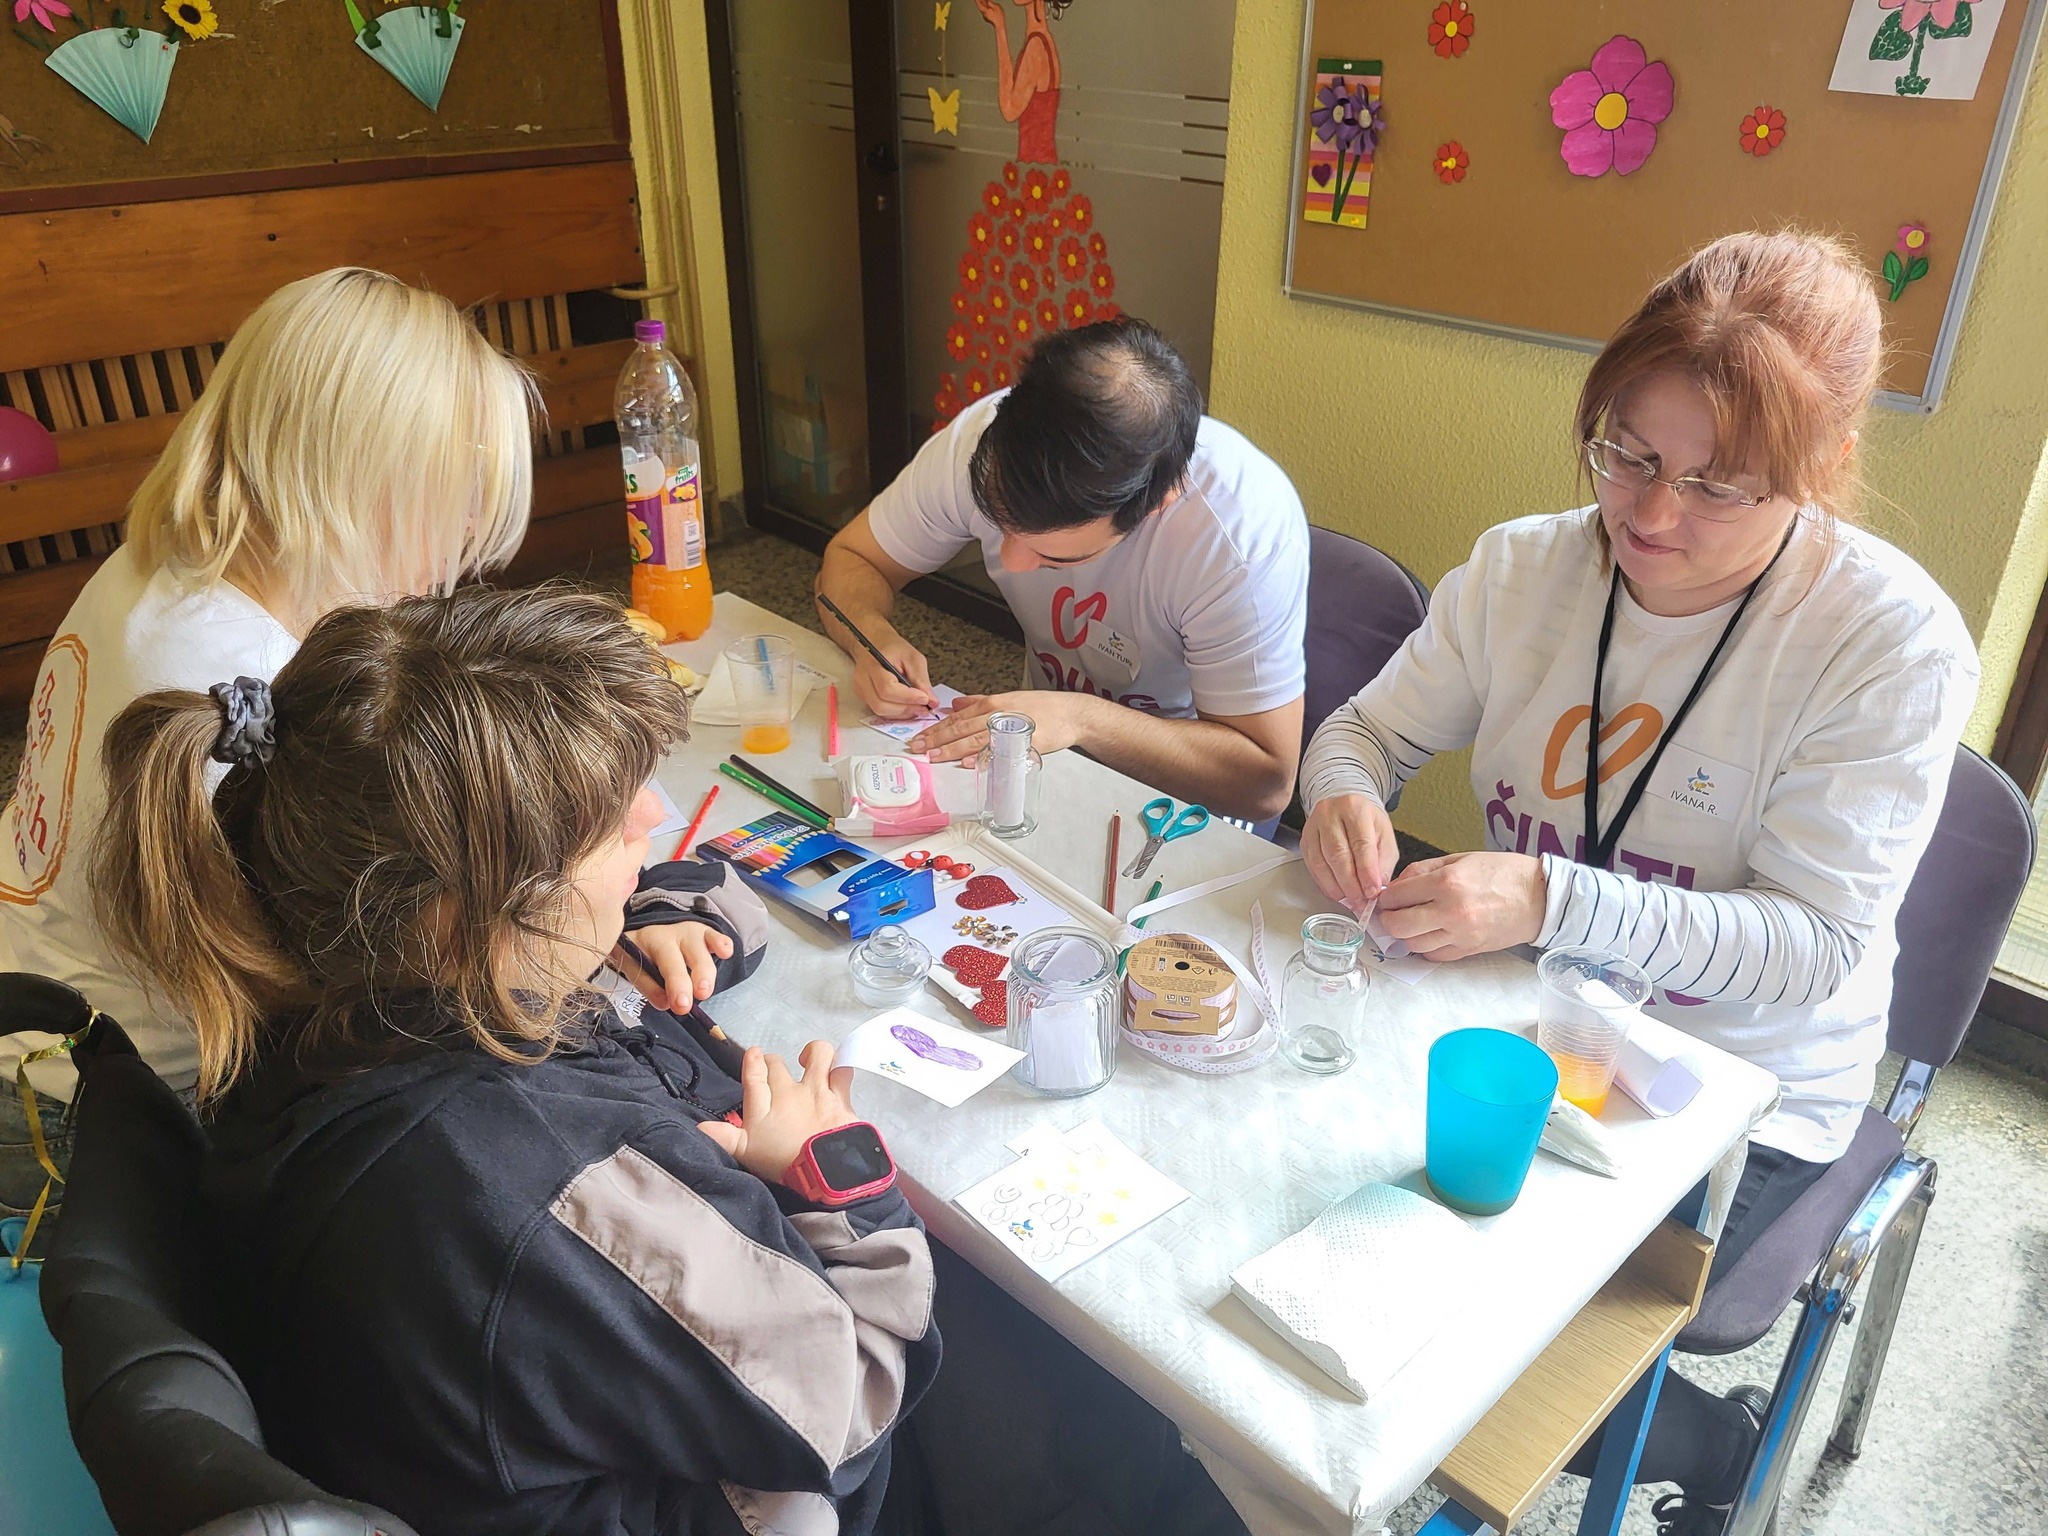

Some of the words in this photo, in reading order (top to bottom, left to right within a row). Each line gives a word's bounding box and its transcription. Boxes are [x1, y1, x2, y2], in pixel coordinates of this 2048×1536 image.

[1098, 642, 1115, 657] IVAN
[1670, 789, 1704, 811] IVANA
[1707, 803, 1718, 816] R.
